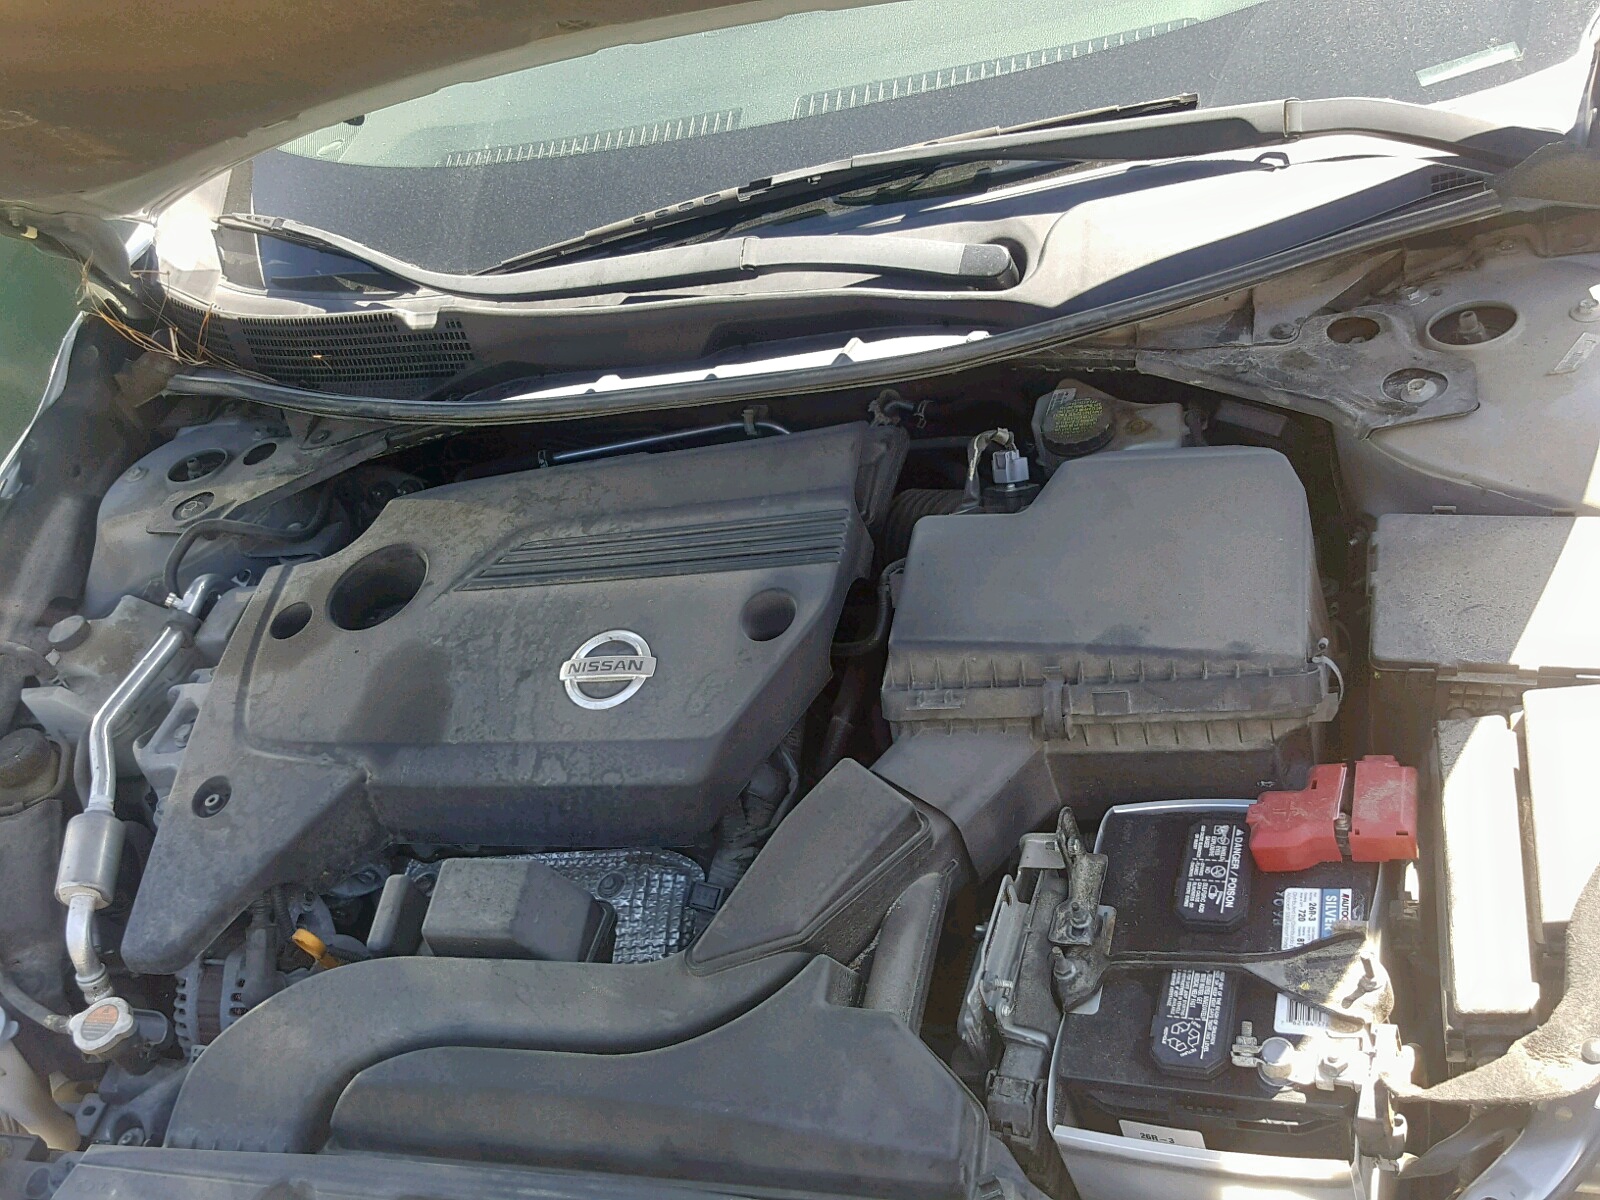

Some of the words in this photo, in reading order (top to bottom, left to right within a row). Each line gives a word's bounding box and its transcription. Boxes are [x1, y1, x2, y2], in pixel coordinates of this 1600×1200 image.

[568, 660, 644, 674] NISSAN
[1231, 836, 1243, 870] DANGER
[1200, 882, 1208, 902] SULFURIC
[1225, 877, 1238, 908] POISON
[1298, 910, 1306, 922] 720
[1308, 902, 1317, 922] 26R-3
[1324, 895, 1337, 930] SILVER
[1341, 896, 1350, 920] AUTOC
